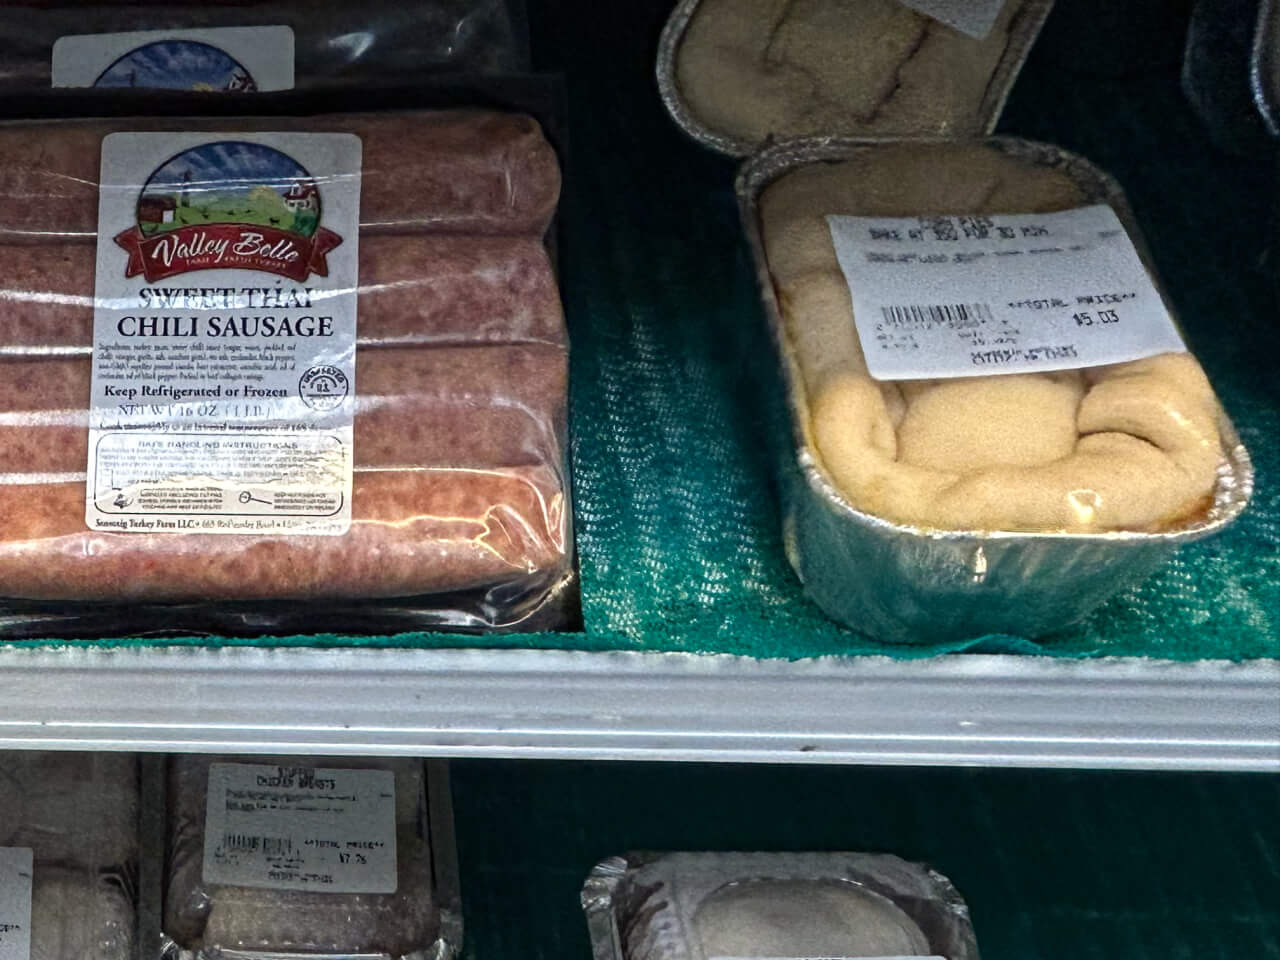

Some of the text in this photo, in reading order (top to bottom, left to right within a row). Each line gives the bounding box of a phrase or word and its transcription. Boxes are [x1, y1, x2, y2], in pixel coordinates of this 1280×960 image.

[152, 232, 300, 267] Valley Belle
[139, 287, 313, 309] SWEET THAI
[117, 316, 334, 337] CHILI SAUSAGE
[105, 385, 288, 400] Keep Refrigerated or Frozen
[180, 404, 193, 416] 16
